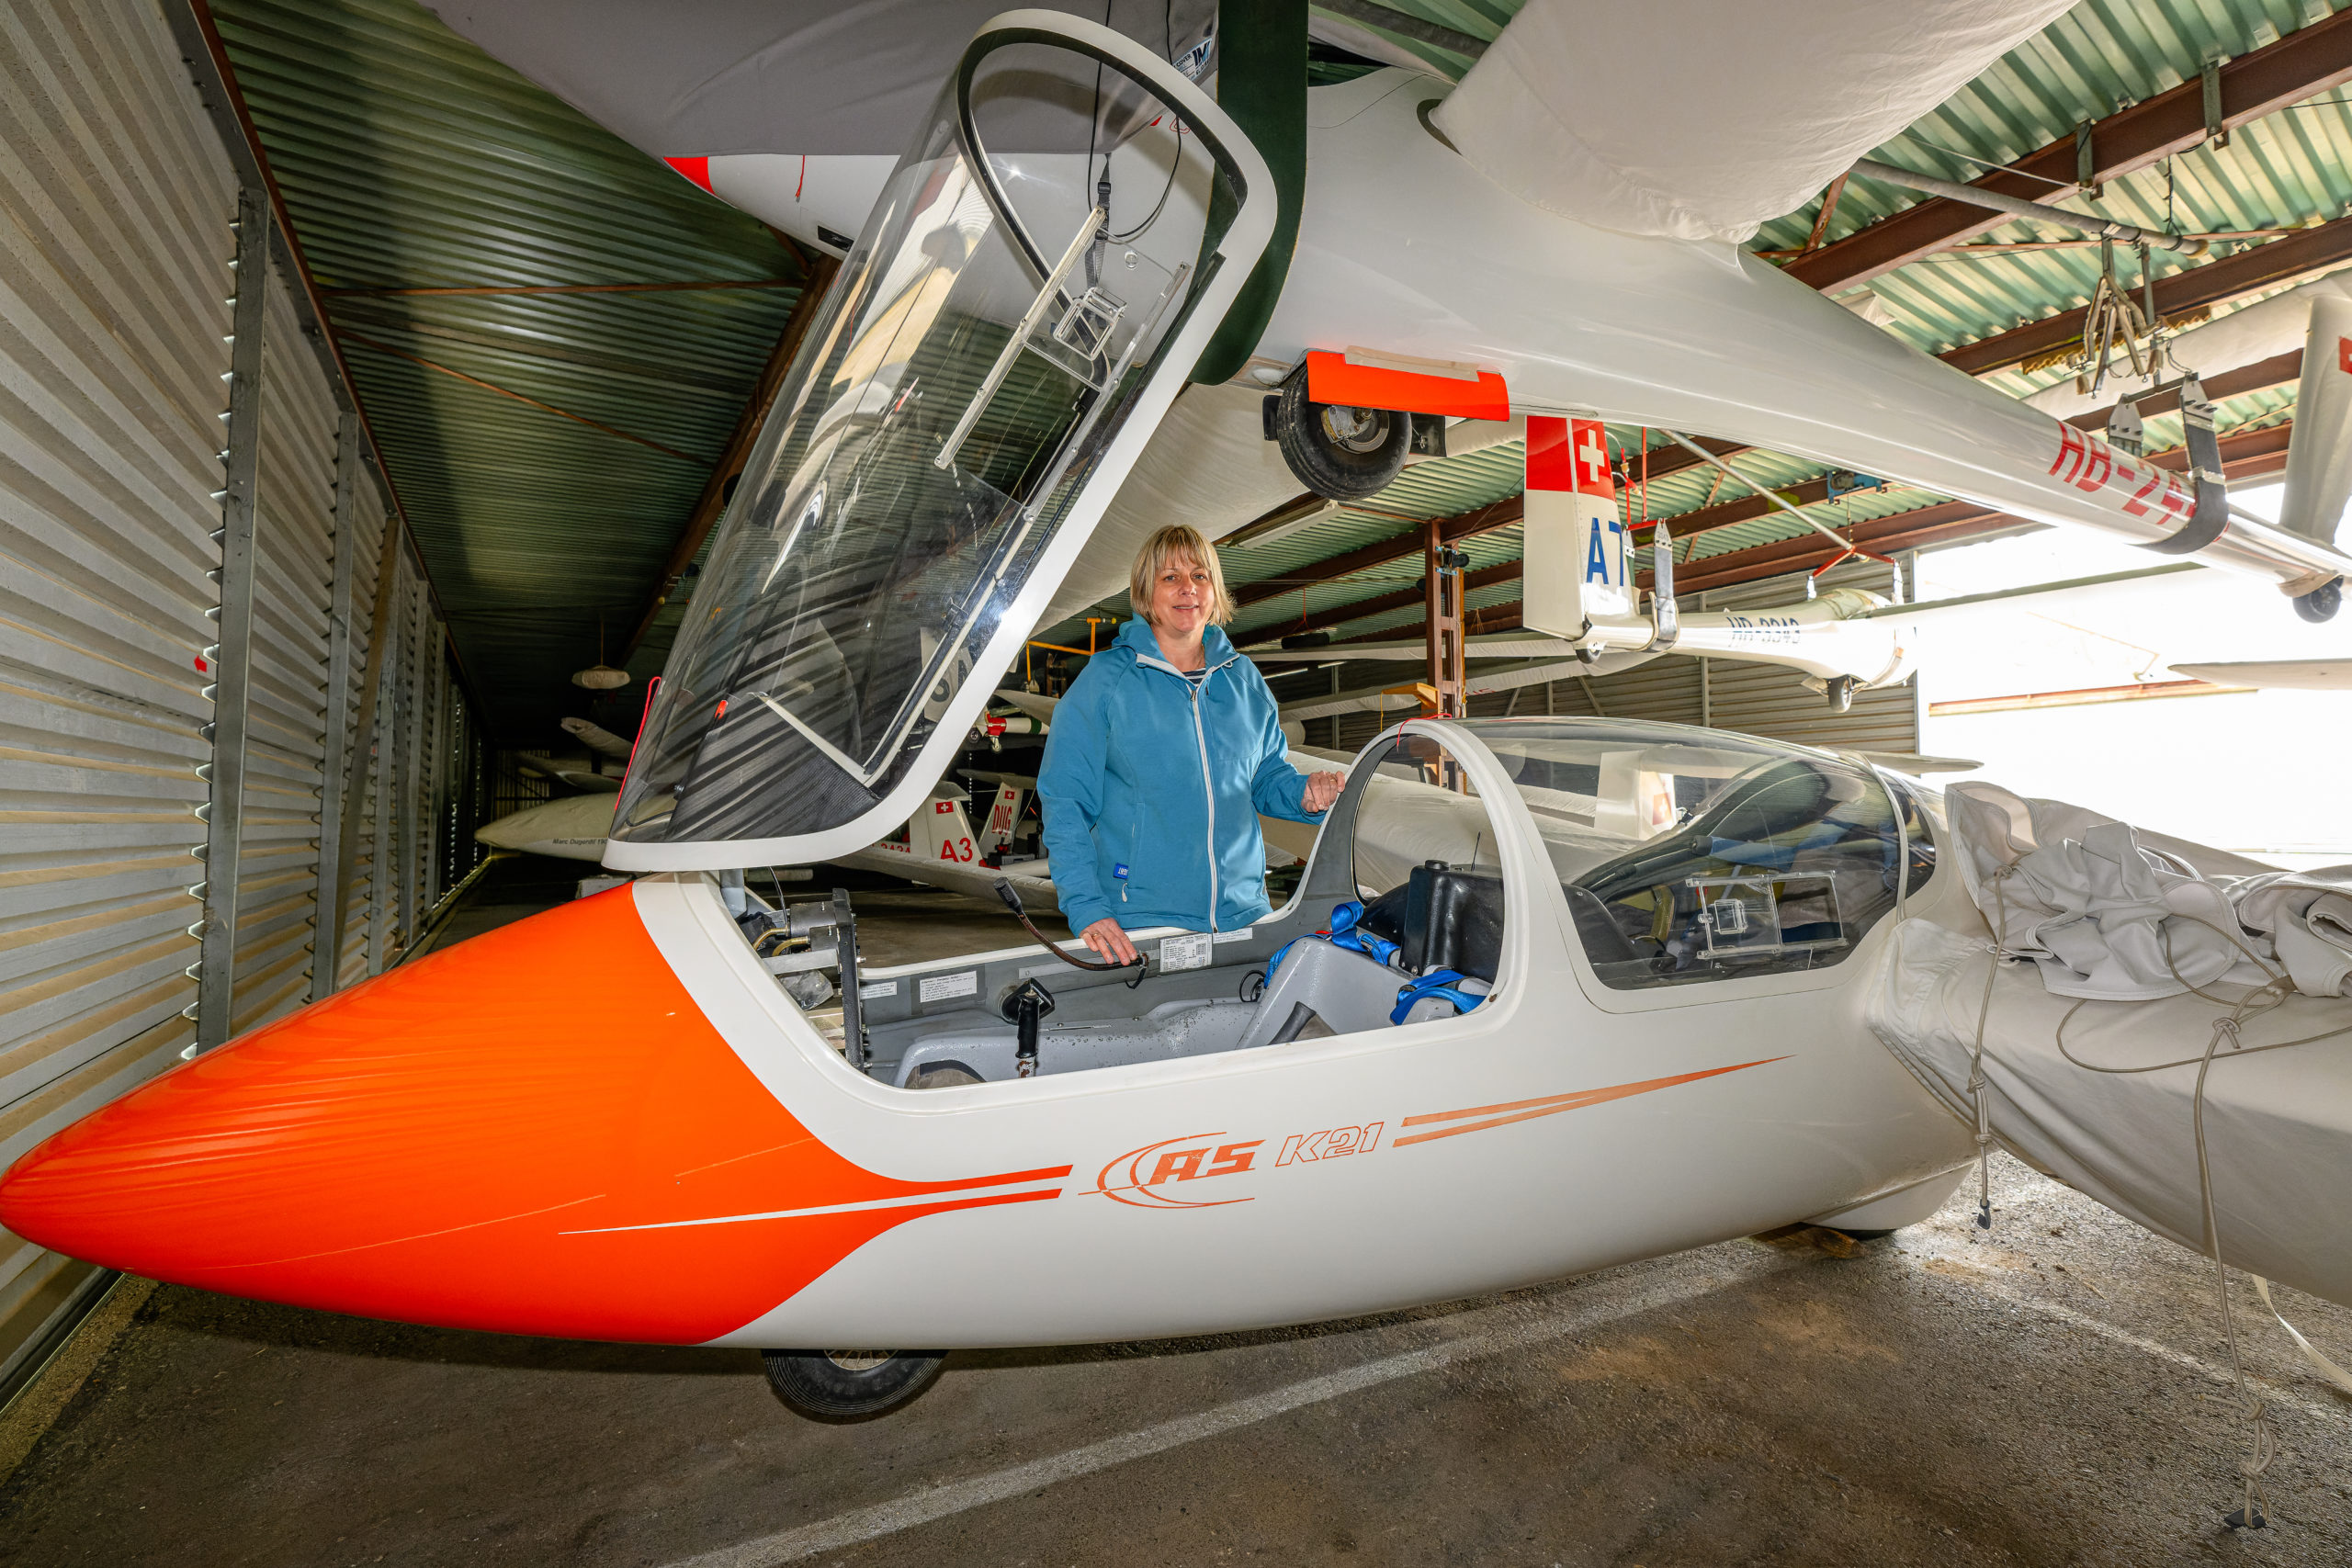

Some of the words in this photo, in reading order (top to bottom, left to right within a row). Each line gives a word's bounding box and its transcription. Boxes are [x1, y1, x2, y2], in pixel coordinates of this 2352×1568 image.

[1176, 53, 1193, 67] COVER
[2048, 421, 2197, 525] HB-24
[991, 804, 1012, 836] DUG
[940, 837, 973, 863] A3
[1148, 1139, 1267, 1186] AS
[1274, 1122, 1385, 1167] K21
